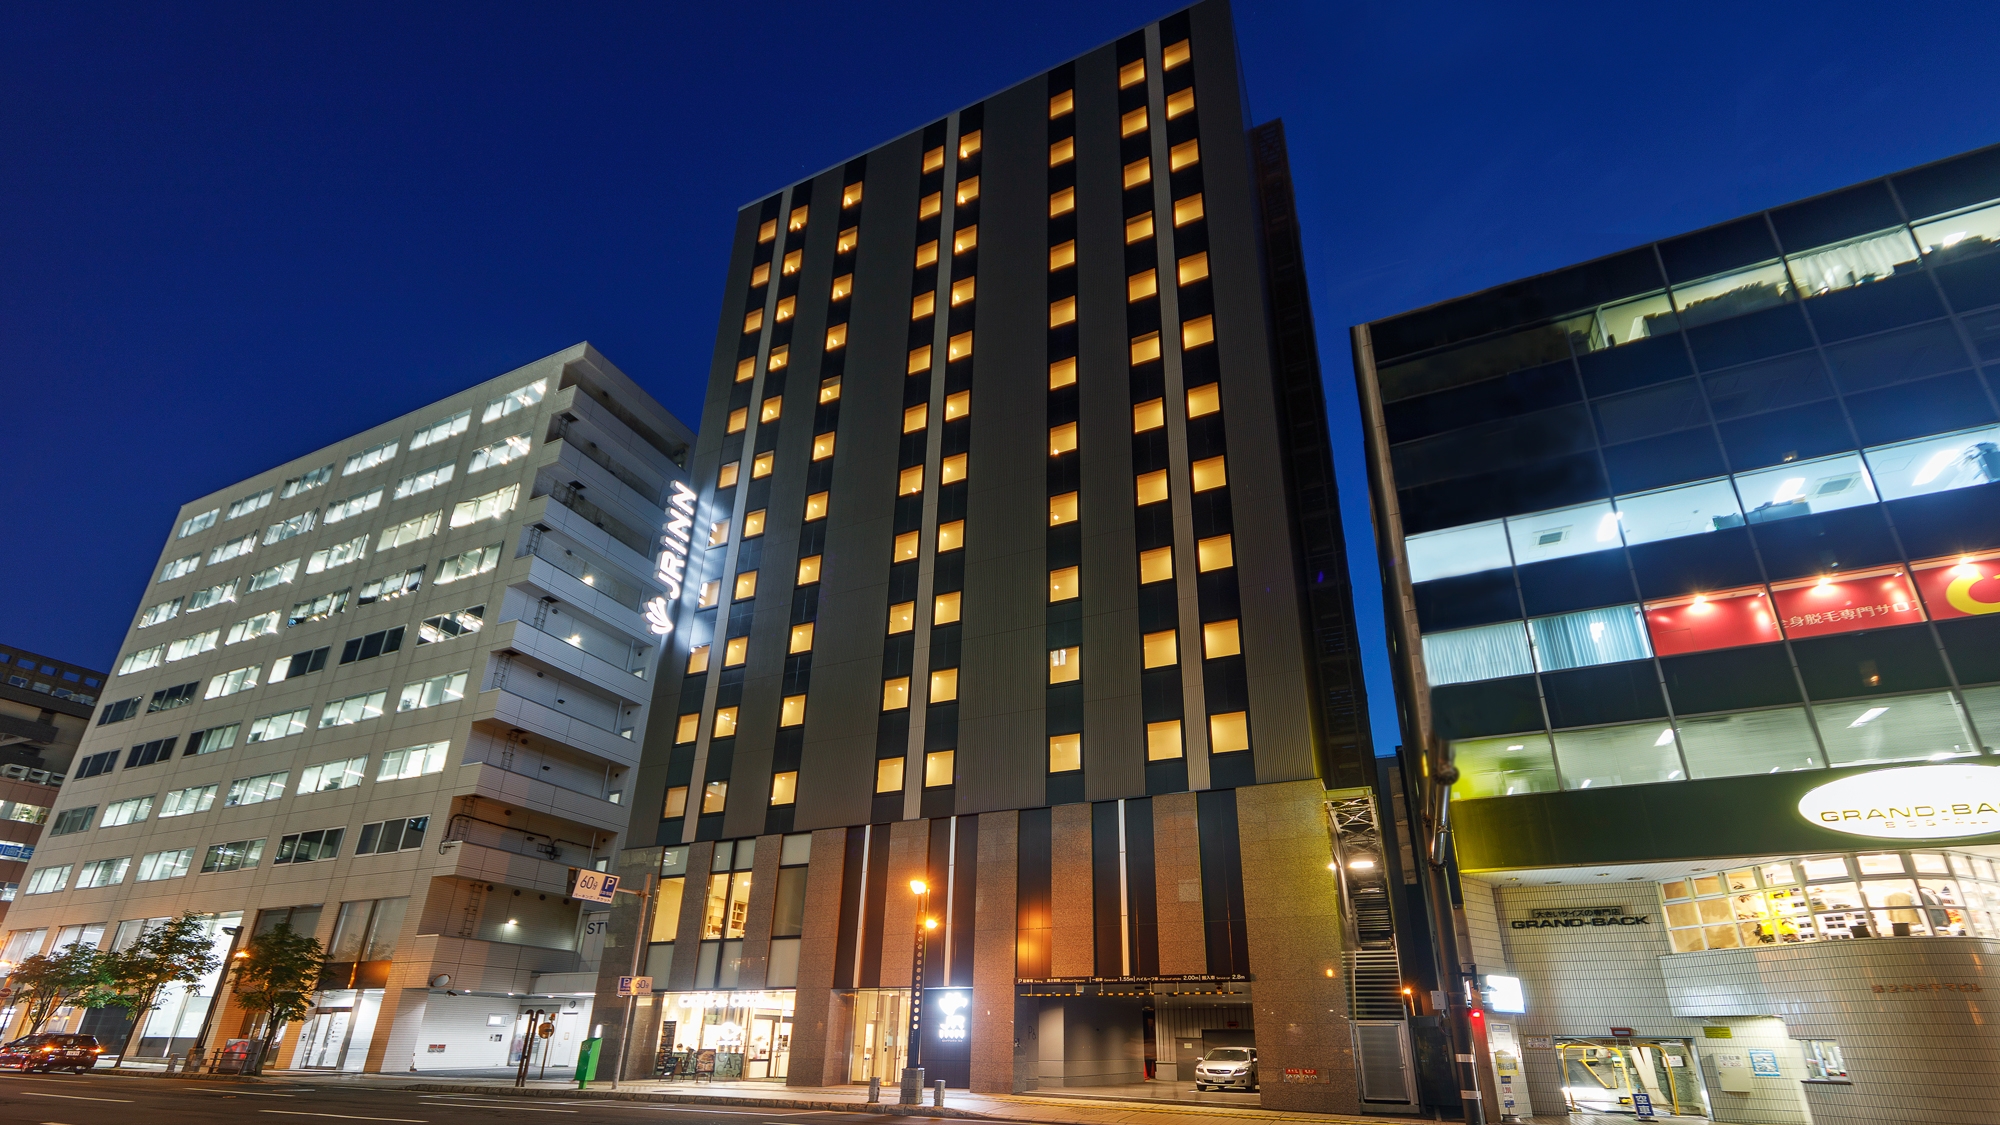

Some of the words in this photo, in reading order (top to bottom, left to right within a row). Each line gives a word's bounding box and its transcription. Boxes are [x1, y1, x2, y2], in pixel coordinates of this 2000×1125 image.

[1820, 802, 2000, 823] GRAND-BA
[580, 875, 598, 891] 60分
[604, 877, 615, 890] P
[1535, 908, 1621, 918] 大きいサイズの専門店
[1511, 916, 1650, 929] GRAND-BACK
[623, 978, 630, 987] P
[1635, 1094, 1654, 1117] 空車
